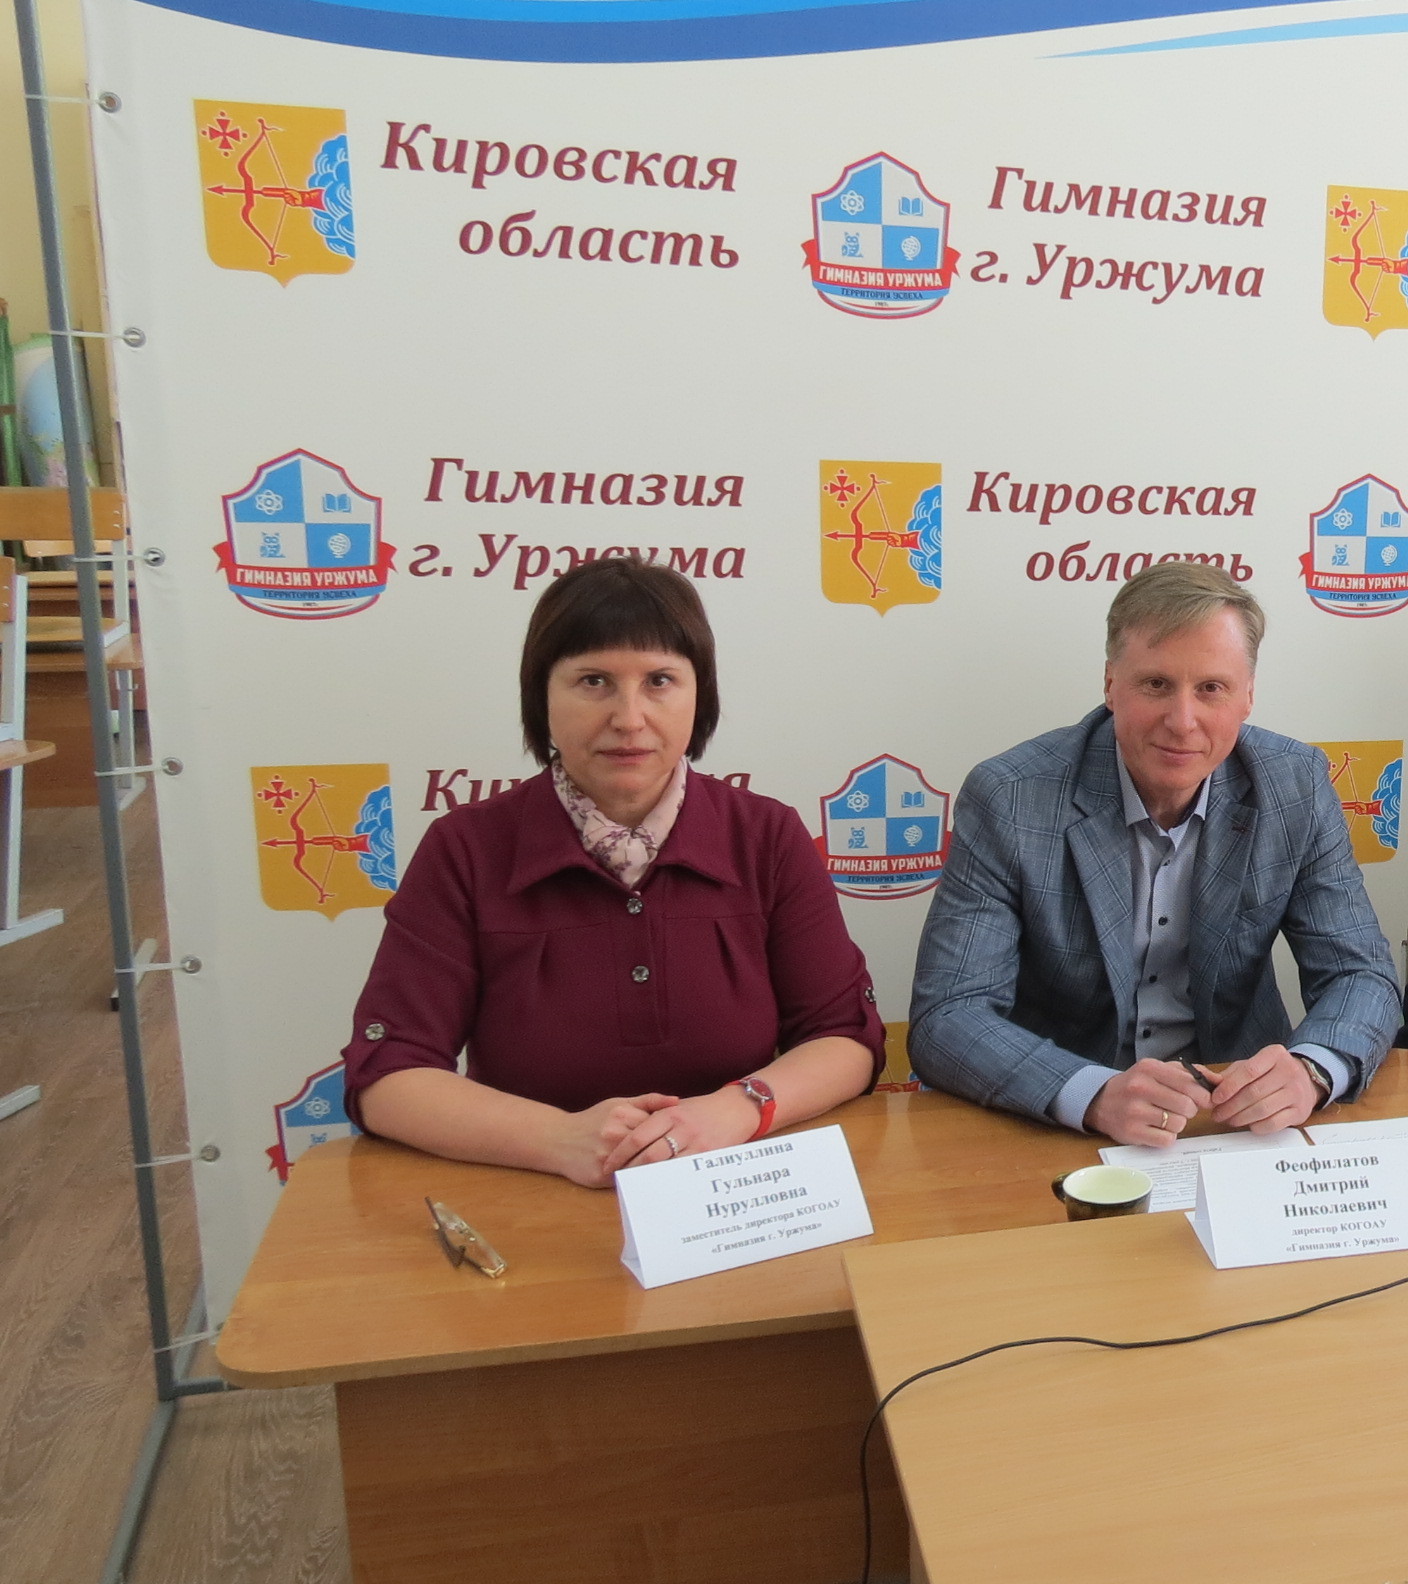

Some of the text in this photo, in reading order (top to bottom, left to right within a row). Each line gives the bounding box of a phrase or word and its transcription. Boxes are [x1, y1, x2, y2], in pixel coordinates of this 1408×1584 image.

[381, 121, 739, 193] Кировская
[988, 165, 1268, 228] Гимназия
[459, 209, 740, 269] область
[819, 265, 943, 287] ГИМНАЗИЯ УРЖУМА
[970, 242, 1265, 305] г. Уржума
[425, 457, 745, 508] Гимназия
[967, 471, 1258, 526] Кировская
[408, 543, 454, 578] г.
[236, 568, 378, 586] ГИМНАЗИЯ УРЖУМА
[1312, 574, 1365, 589] ГИМНАЗИЯ
[827, 854, 943, 871] ГИМНАЗИЯ УРЖУМА
[692, 1139, 795, 1172] Галиуллина
[1275, 1155, 1380, 1174] Феофилатов
[710, 1165, 792, 1195] Гульнара
[1293, 1176, 1371, 1197] Дмитрий
[705, 1184, 809, 1219] Нурулловна
[1283, 1199, 1389, 1218] Николаевич
[681, 1198, 842, 1244] заместитель директора КОГОАУ
[711, 1235, 767, 1253] «Гимназия
[777, 1221, 823, 1239] Уржума»
[1291, 1219, 1388, 1237] директор КОГОАУ
[1286, 1242, 1341, 1253] «Гимназия
[1353, 1236, 1400, 1248] Уржума»
